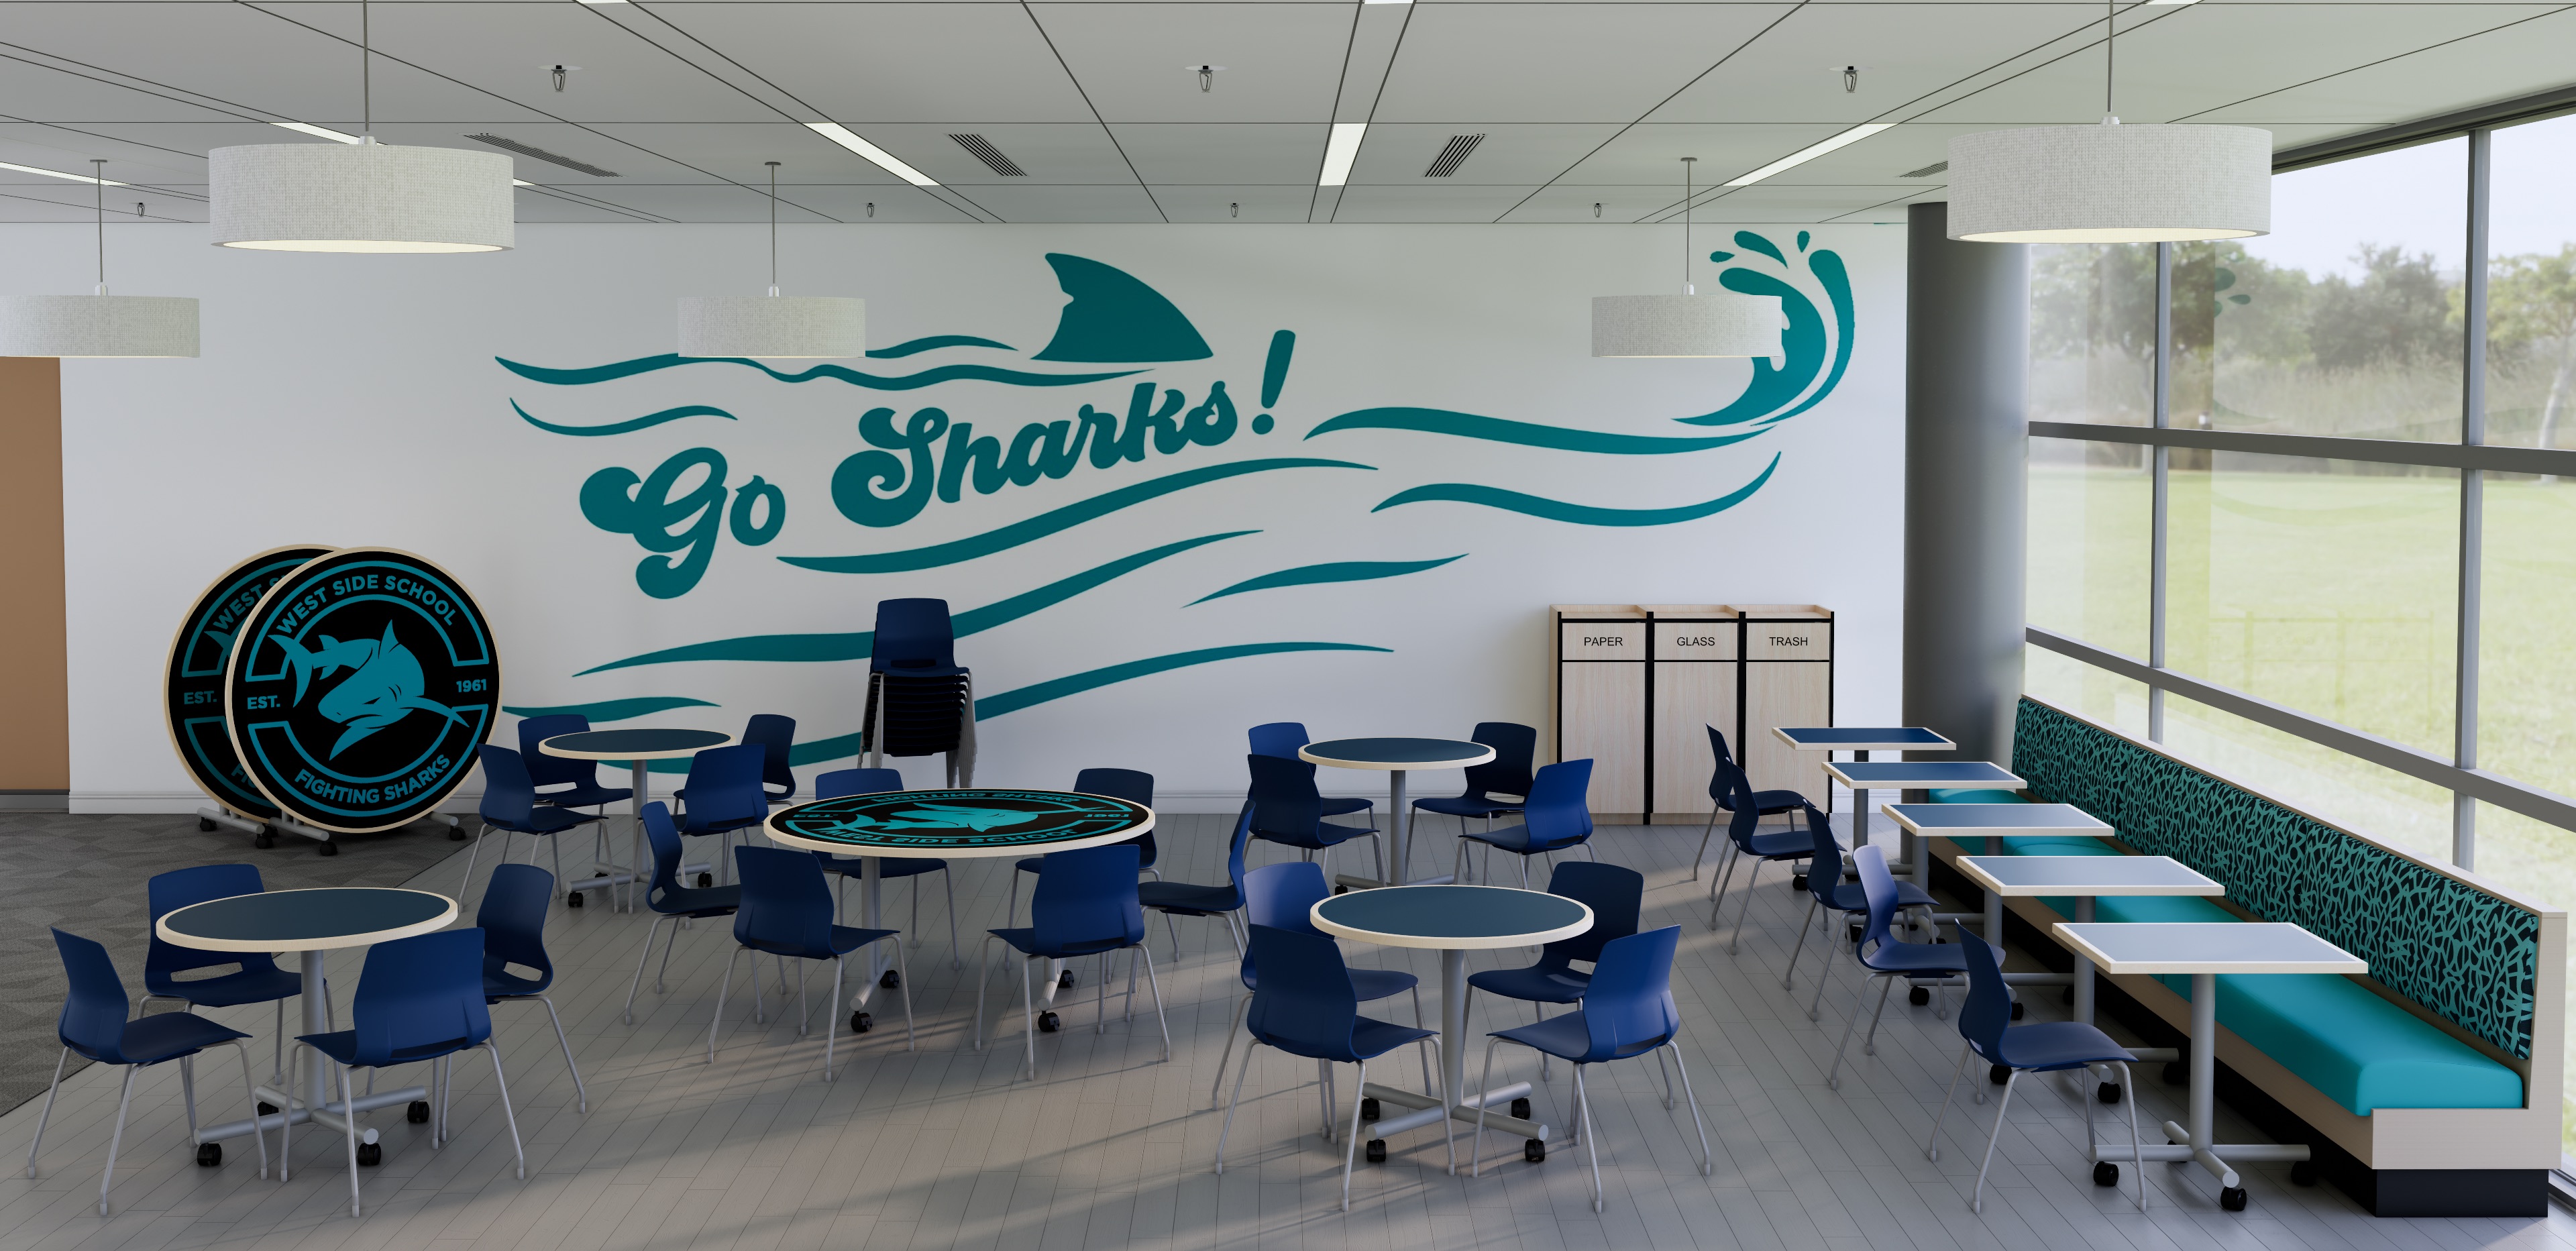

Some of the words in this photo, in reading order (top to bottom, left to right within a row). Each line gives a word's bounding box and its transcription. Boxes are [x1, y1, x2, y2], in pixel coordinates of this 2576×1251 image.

[579, 447, 786, 600] Go
[830, 329, 1296, 529] Sharks!
[213, 584, 263, 630] WEST
[276, 586, 327, 634] WEST
[332, 574, 379, 596] SIDE
[384, 575, 456, 627] SCHOOL
[1584, 637, 1623, 647] PAPER
[1676, 637, 1715, 647] GLASS
[1768, 637, 1808, 647] TRASH
[455, 678, 487, 693] 1961
[184, 690, 217, 705] EST.
[247, 695, 281, 710] EST.
[294, 768, 380, 804] FIGHTING
[384, 754, 450, 801] SHARKS
